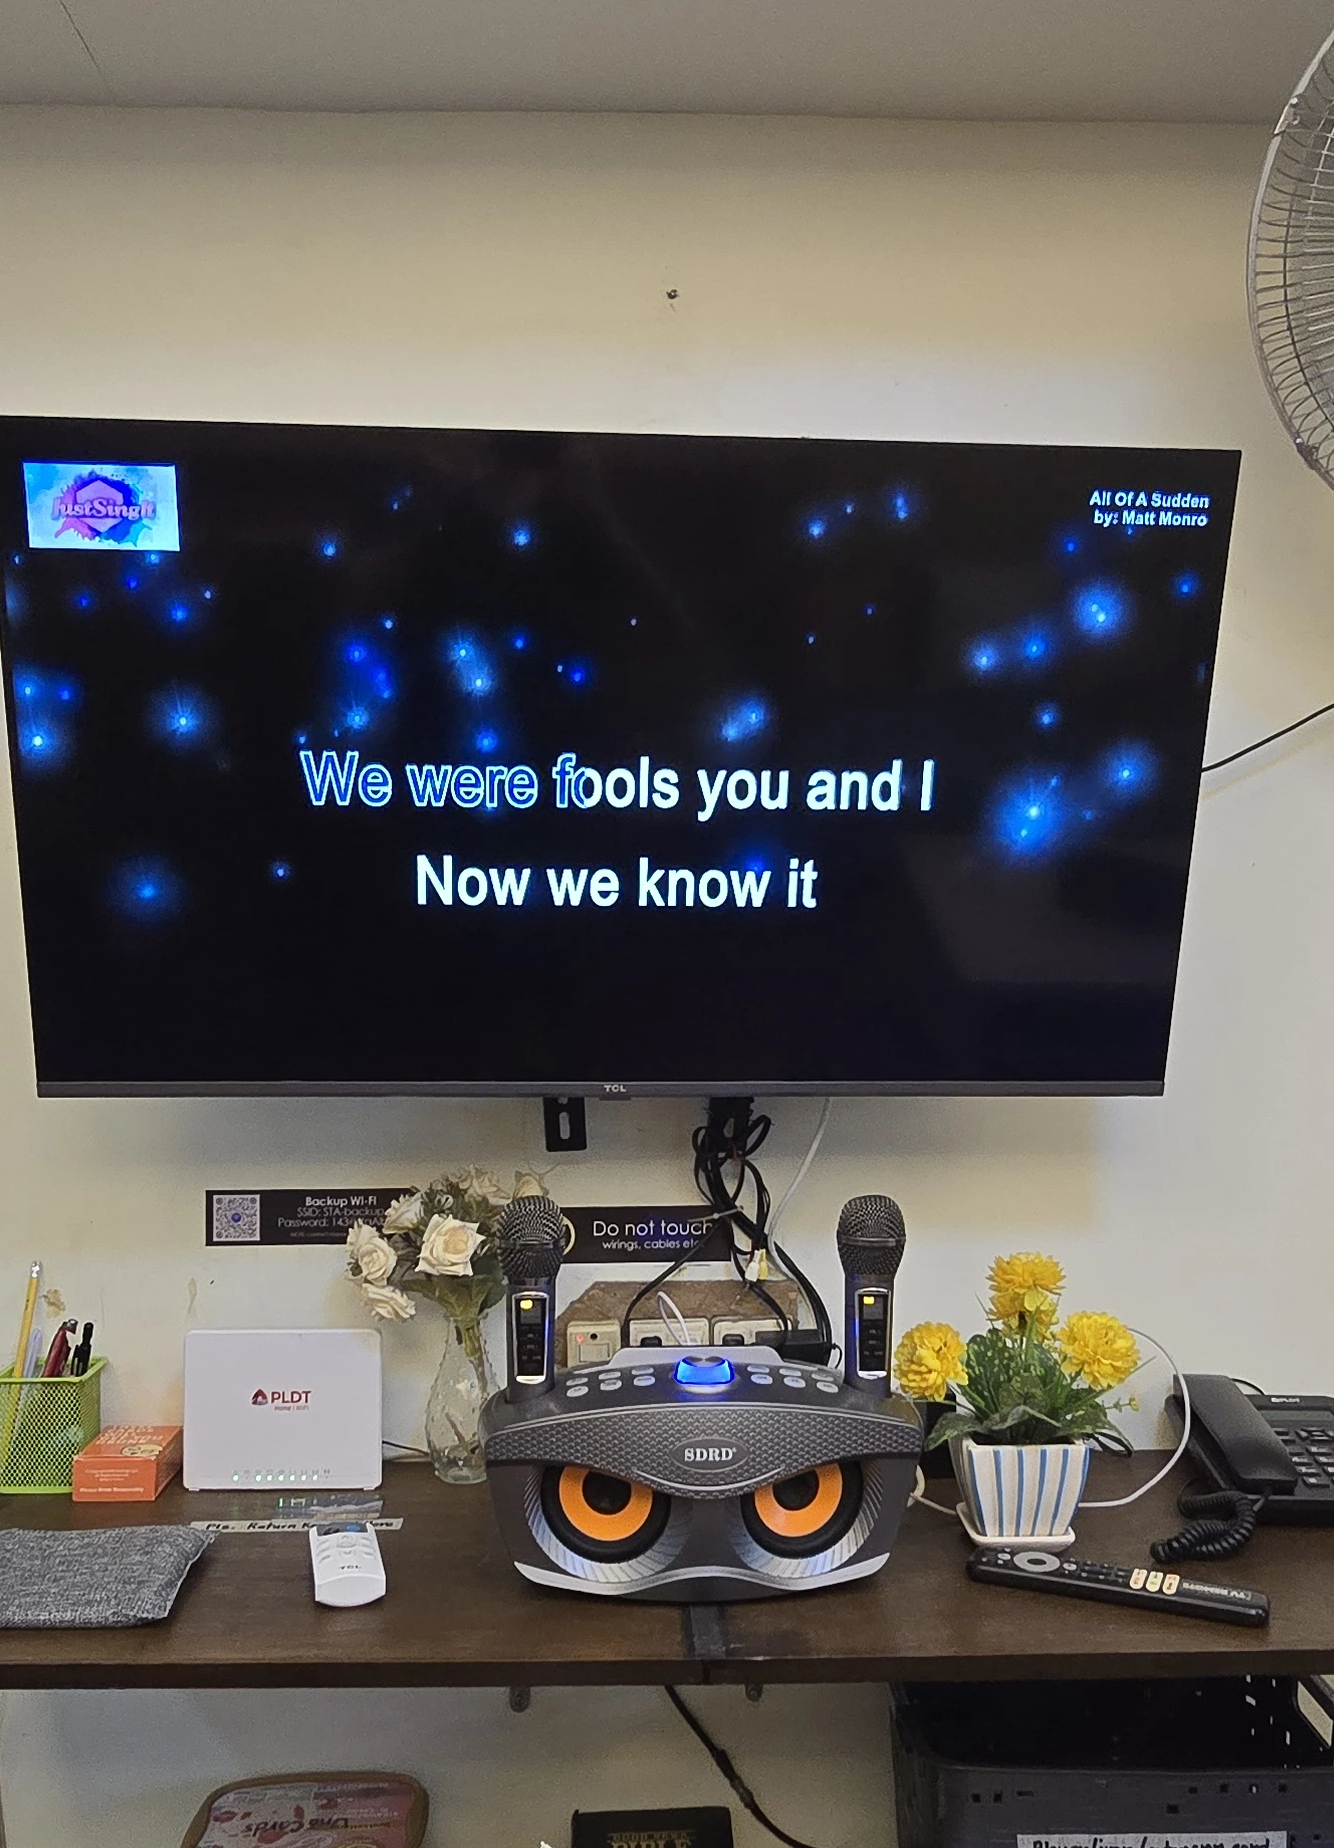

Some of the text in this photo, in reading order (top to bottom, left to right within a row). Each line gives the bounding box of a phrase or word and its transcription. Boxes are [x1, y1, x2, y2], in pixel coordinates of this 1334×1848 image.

[1089, 490, 1210, 508] All Of A Sudden
[1093, 509, 1208, 527] by: Matt Monro
[299, 750, 935, 822] We were fools you and I
[416, 854, 818, 909] Now we know it
[603, 1084, 627, 1092] TCL
[305, 1196, 348, 1208] Backup
[297, 1207, 321, 1217] SSID:
[278, 1217, 329, 1228] Password:
[593, 1220, 620, 1236] Do
[625, 1219, 655, 1236] not
[602, 1239, 642, 1252] wirings,
[643, 1239, 680, 1249] cables
[270, 1390, 312, 1404] PLDT
[684, 1447, 733, 1462] SDRD
[244, 1818, 305, 1837] Cards
